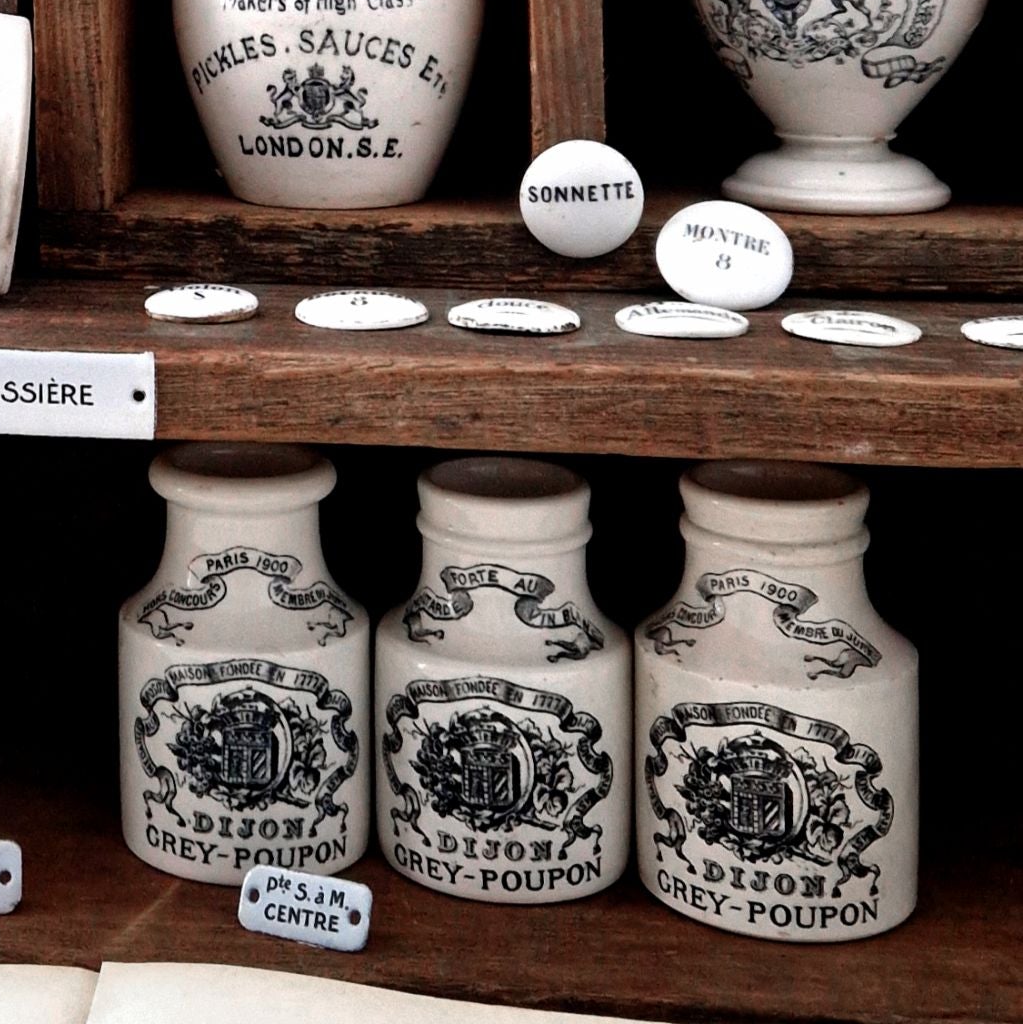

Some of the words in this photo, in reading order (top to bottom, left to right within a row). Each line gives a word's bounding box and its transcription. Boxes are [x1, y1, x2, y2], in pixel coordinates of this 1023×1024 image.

[527, 180, 636, 204] SONNETTE
[682, 223, 771, 257] MONTRE
[715, 252, 733, 271] 8
[206, 551, 250, 572] PARIS
[255, 555, 289, 574] 1900
[168, 582, 221, 607] CONCOURS
[272, 584, 315, 606] MEMBRE
[450, 569, 500, 587] FORTE
[513, 578, 539, 593] AU
[710, 575, 750, 591] PARIS
[759, 581, 799, 603] 1900
[528, 608, 557, 627] VIN
[777, 612, 829, 640] MEMBRE
[410, 682, 447, 699] MAISON
[193, 811, 307, 840] DIJON
[145, 824, 348, 870] GREY-POUPON
[436, 829, 553, 862] DIJON
[393, 842, 603, 892] GREY-POUPON
[703, 858, 826, 898] DIJON
[294, 882, 311, 902] S.
[314, 885, 325, 905] à
[329, 889, 350, 911] M.
[656, 869, 880, 929] GREY-POUPON
[263, 902, 340, 933] CENTRE
